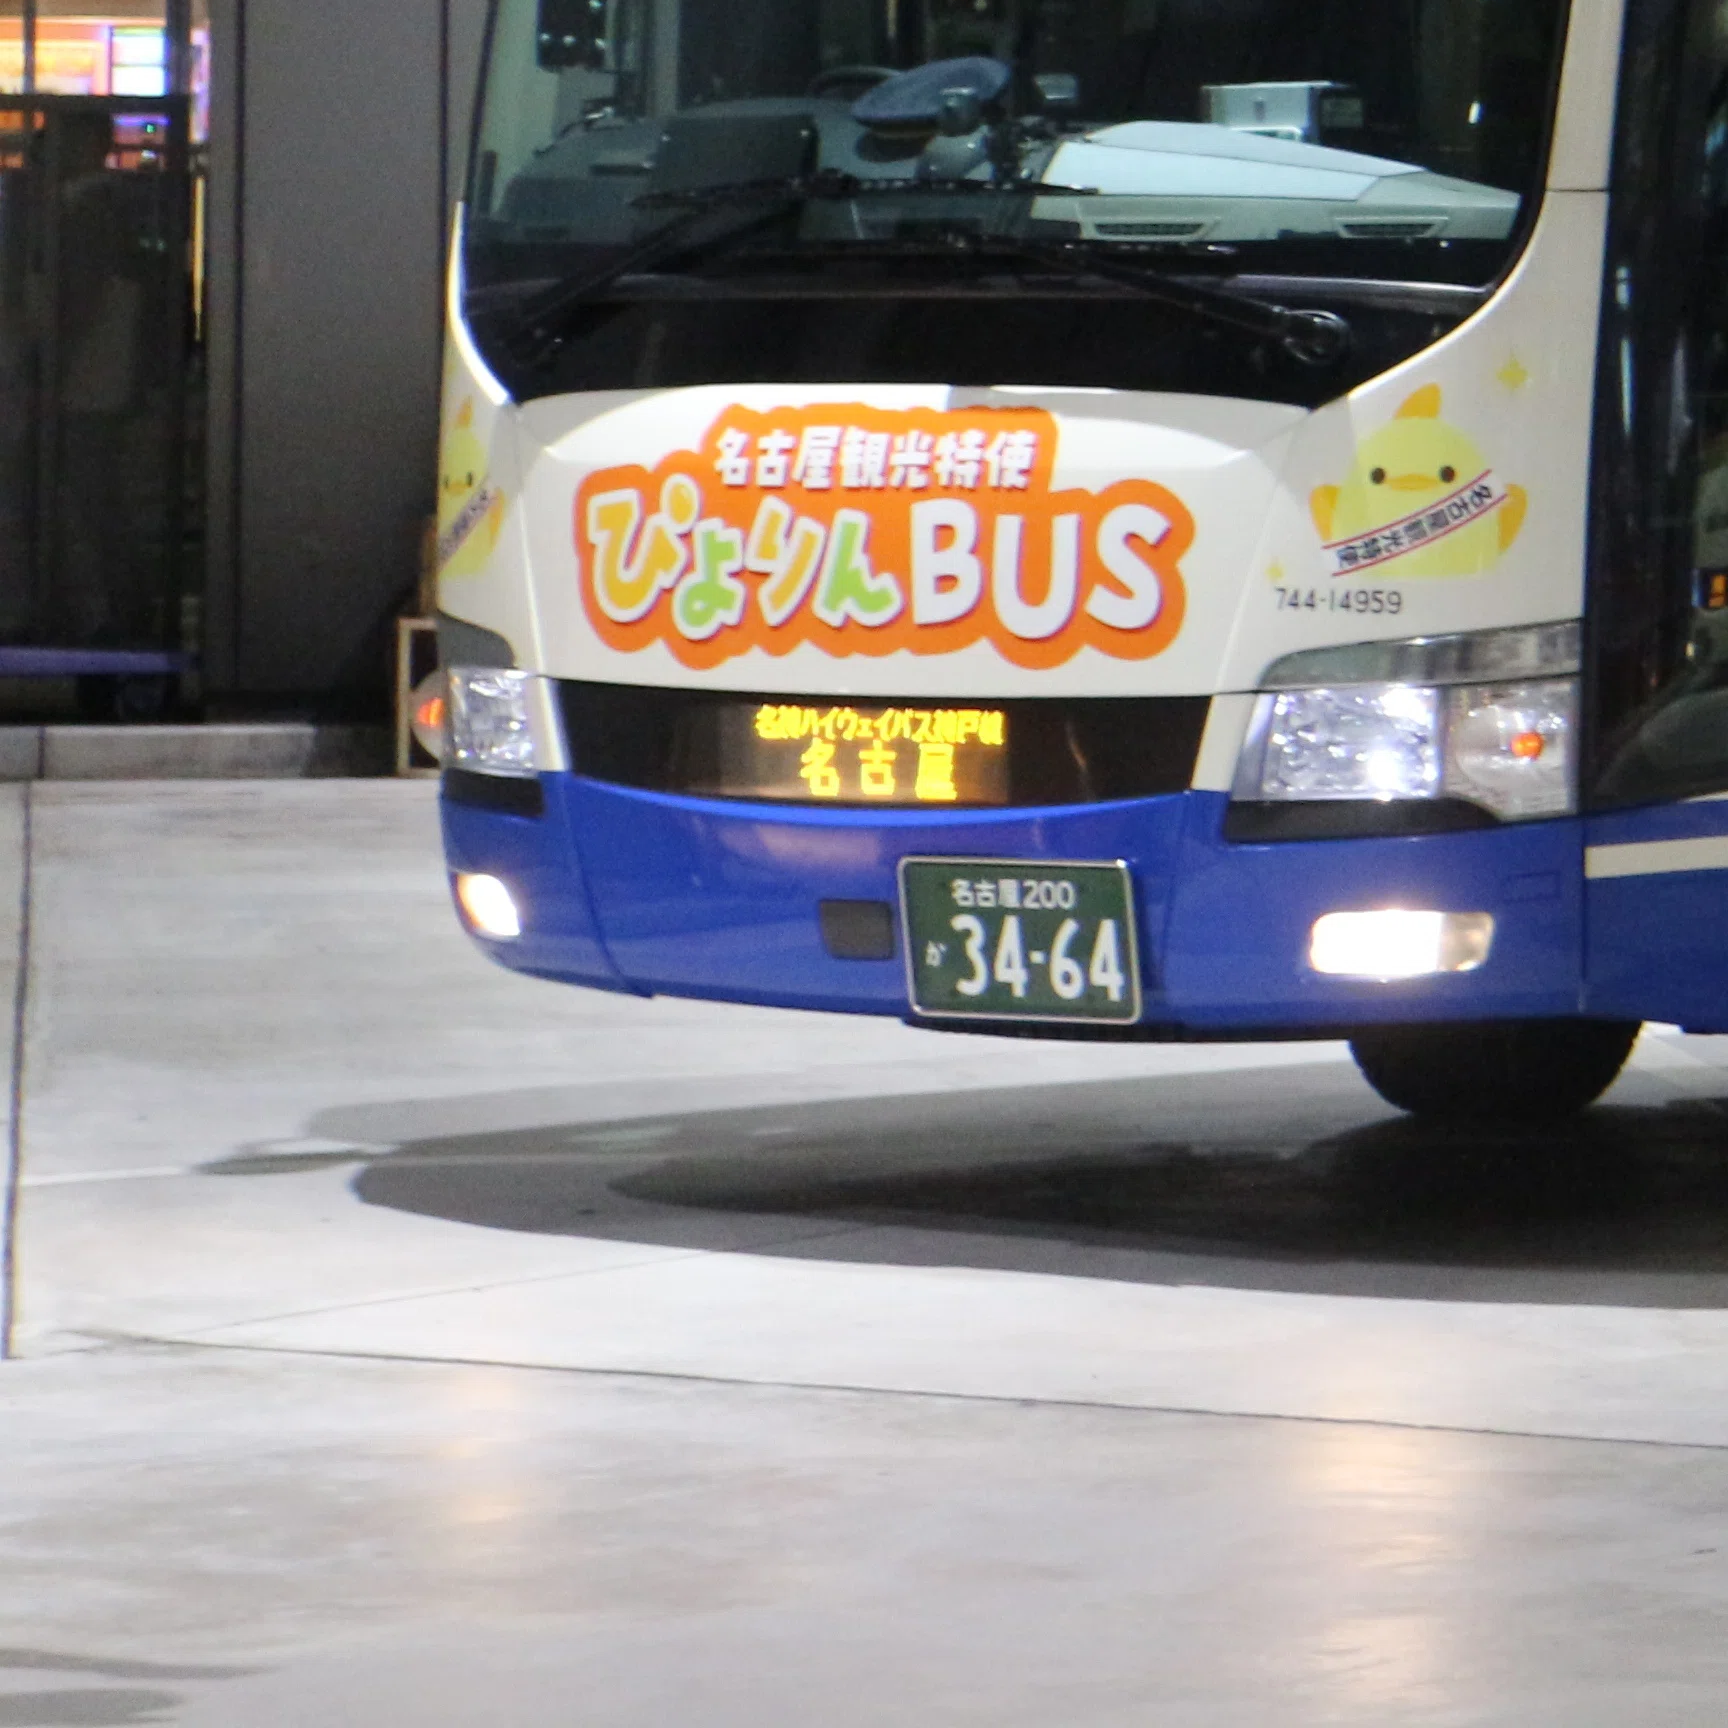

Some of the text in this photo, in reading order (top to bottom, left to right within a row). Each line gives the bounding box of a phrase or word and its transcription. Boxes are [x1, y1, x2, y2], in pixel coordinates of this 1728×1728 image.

[712, 425, 1038, 490] 名古屋観光特使
[1275, 587, 1403, 615] 744-14959
[799, 737, 958, 801] 名古屋
[951, 914, 1125, 1002] 34-64
